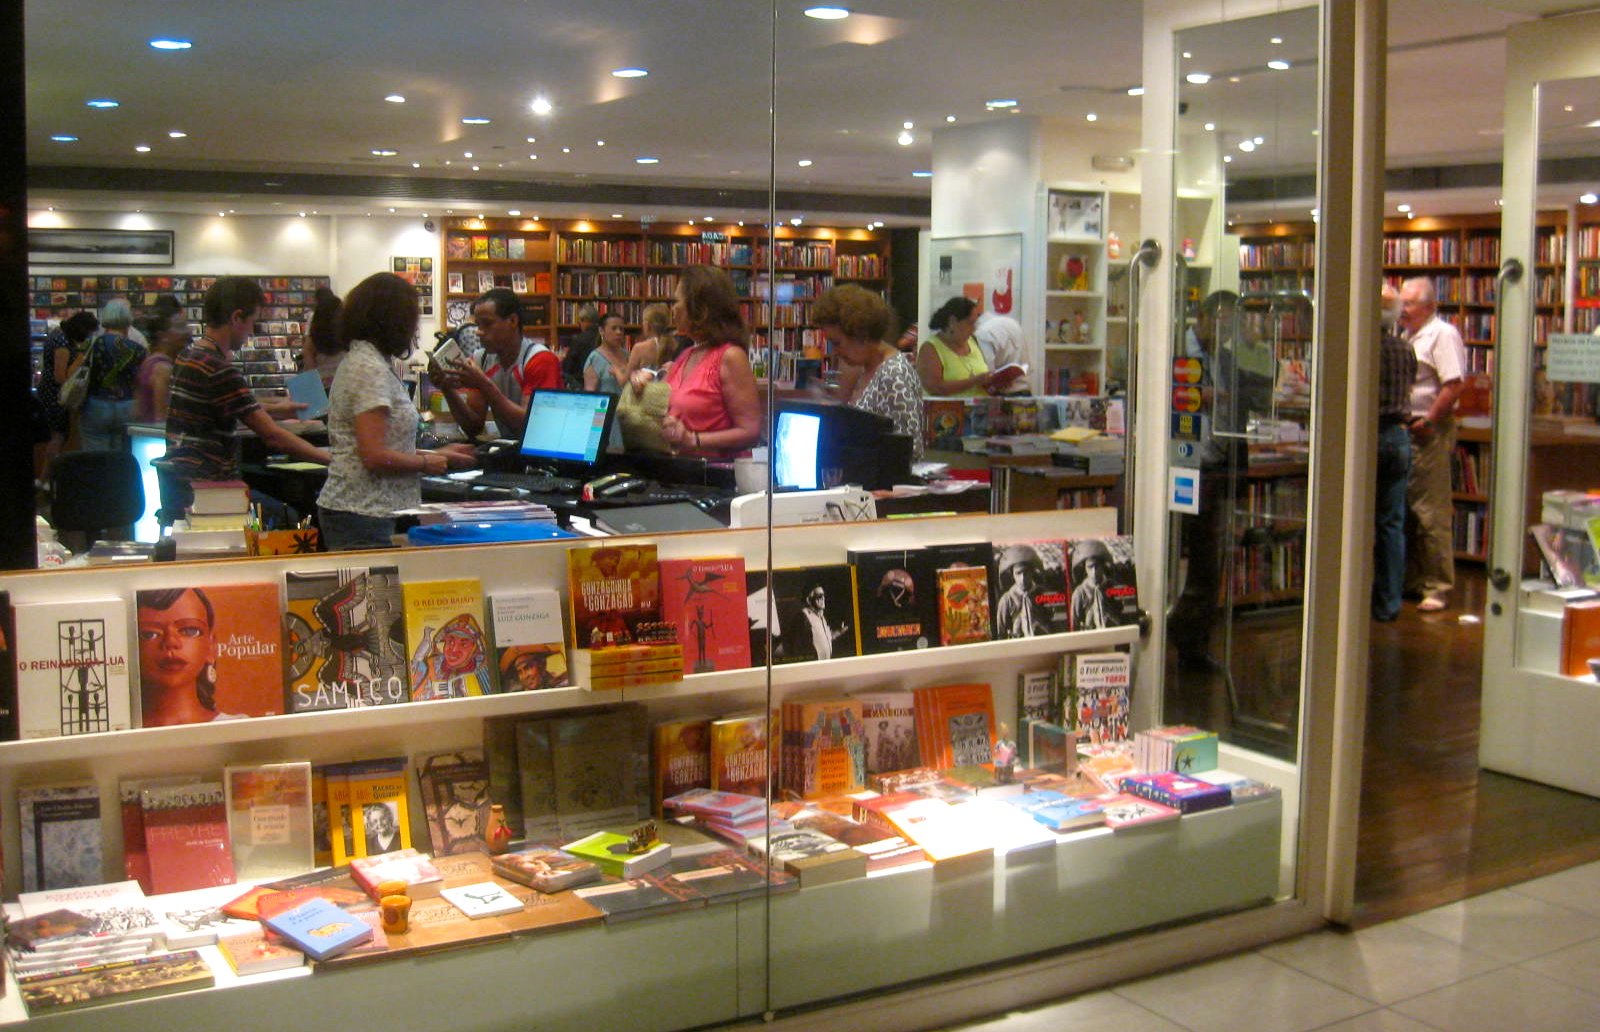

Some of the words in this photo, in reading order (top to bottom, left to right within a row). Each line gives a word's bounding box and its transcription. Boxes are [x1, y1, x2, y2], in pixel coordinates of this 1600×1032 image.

[229, 633, 255, 645] Arte
[217, 640, 277, 660] Popular
[19, 662, 27, 671] O
[104, 656, 125, 667] LUA
[298, 676, 403, 708] SAMICO
